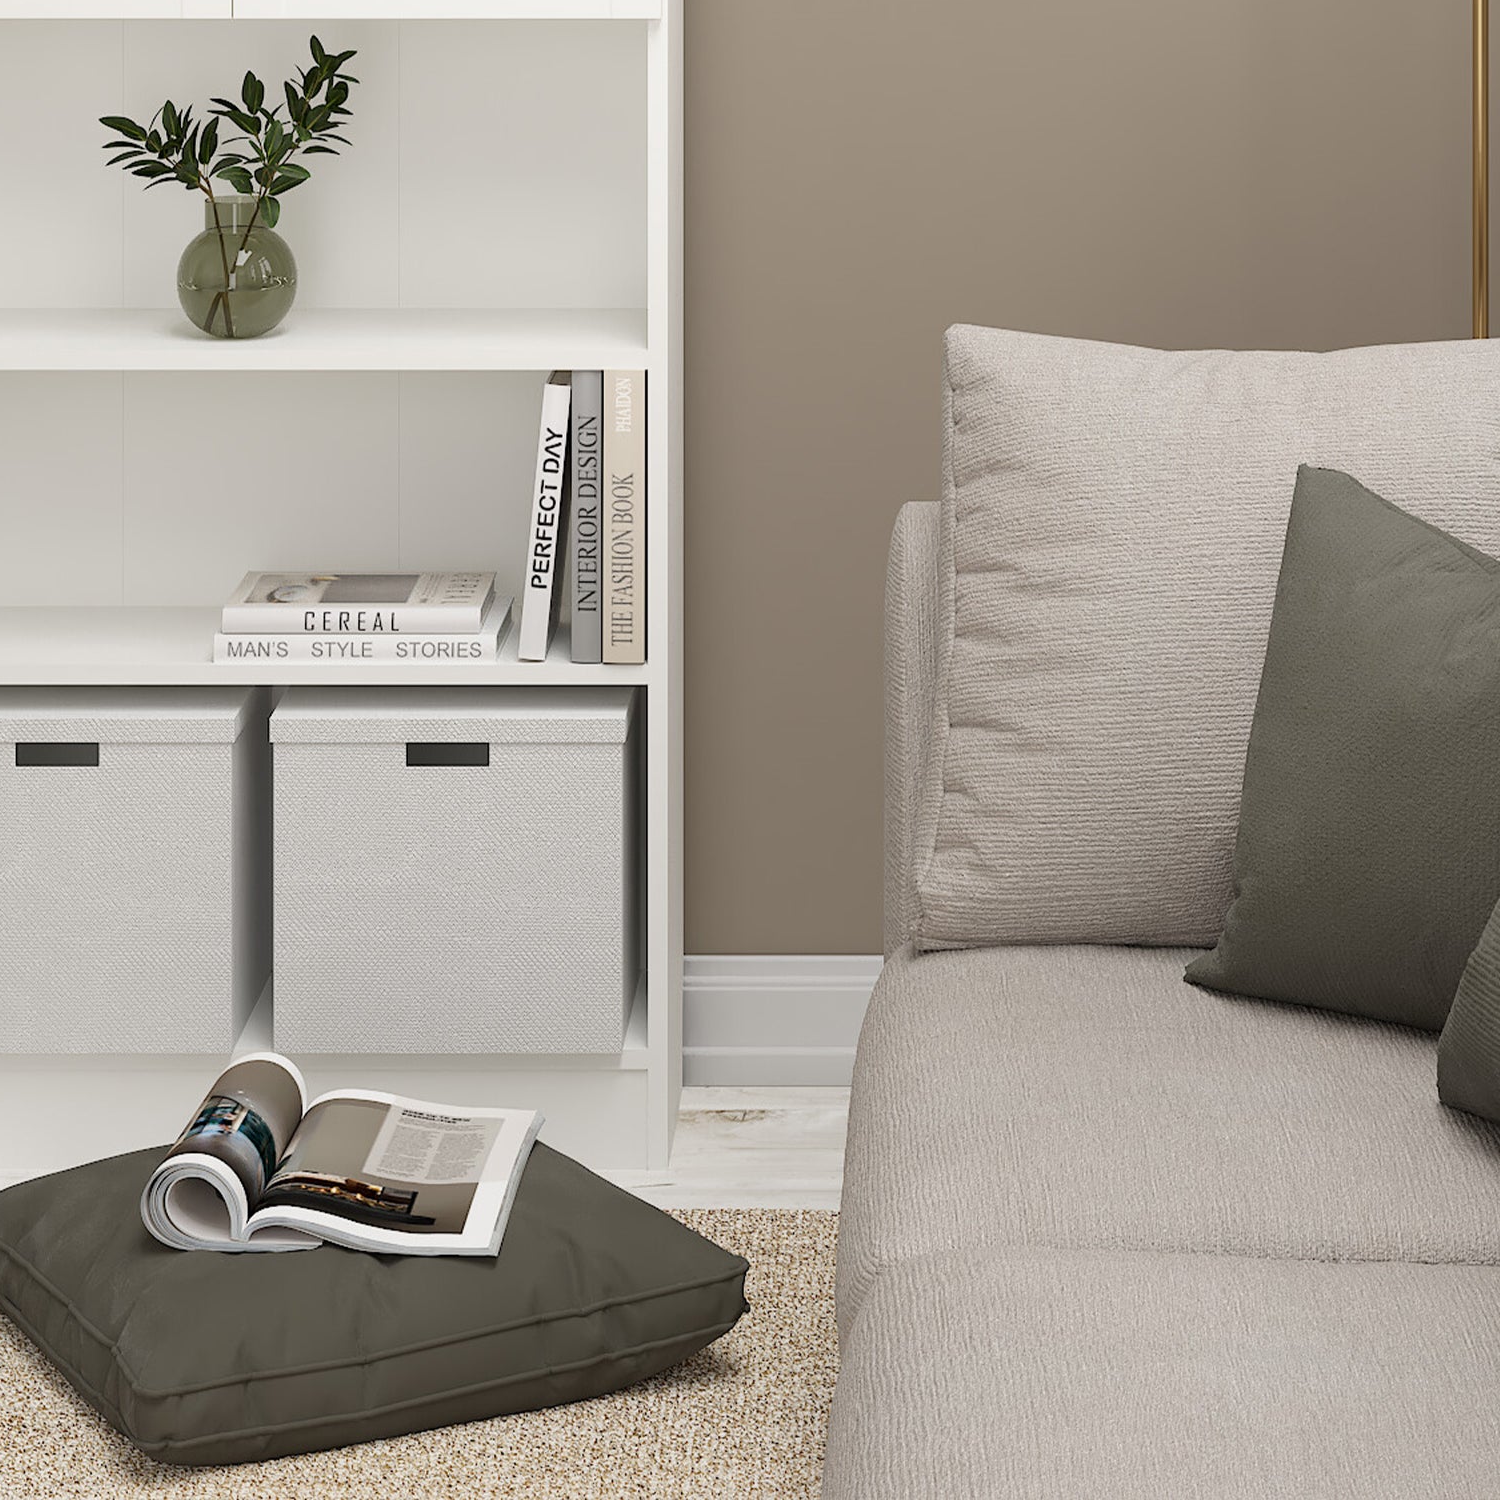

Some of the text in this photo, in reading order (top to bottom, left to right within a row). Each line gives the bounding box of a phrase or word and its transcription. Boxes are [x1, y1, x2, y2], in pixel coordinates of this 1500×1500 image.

[614, 377, 632, 433] PHAIDON
[530, 426, 564, 590] PERFECT DAY
[576, 415, 598, 612] INTERIOR DESIGN
[610, 473, 634, 647] THE FASHION BOOK
[227, 641, 482, 659] MAN'S STYLE STORIES
[303, 611, 401, 632] CEREAL
